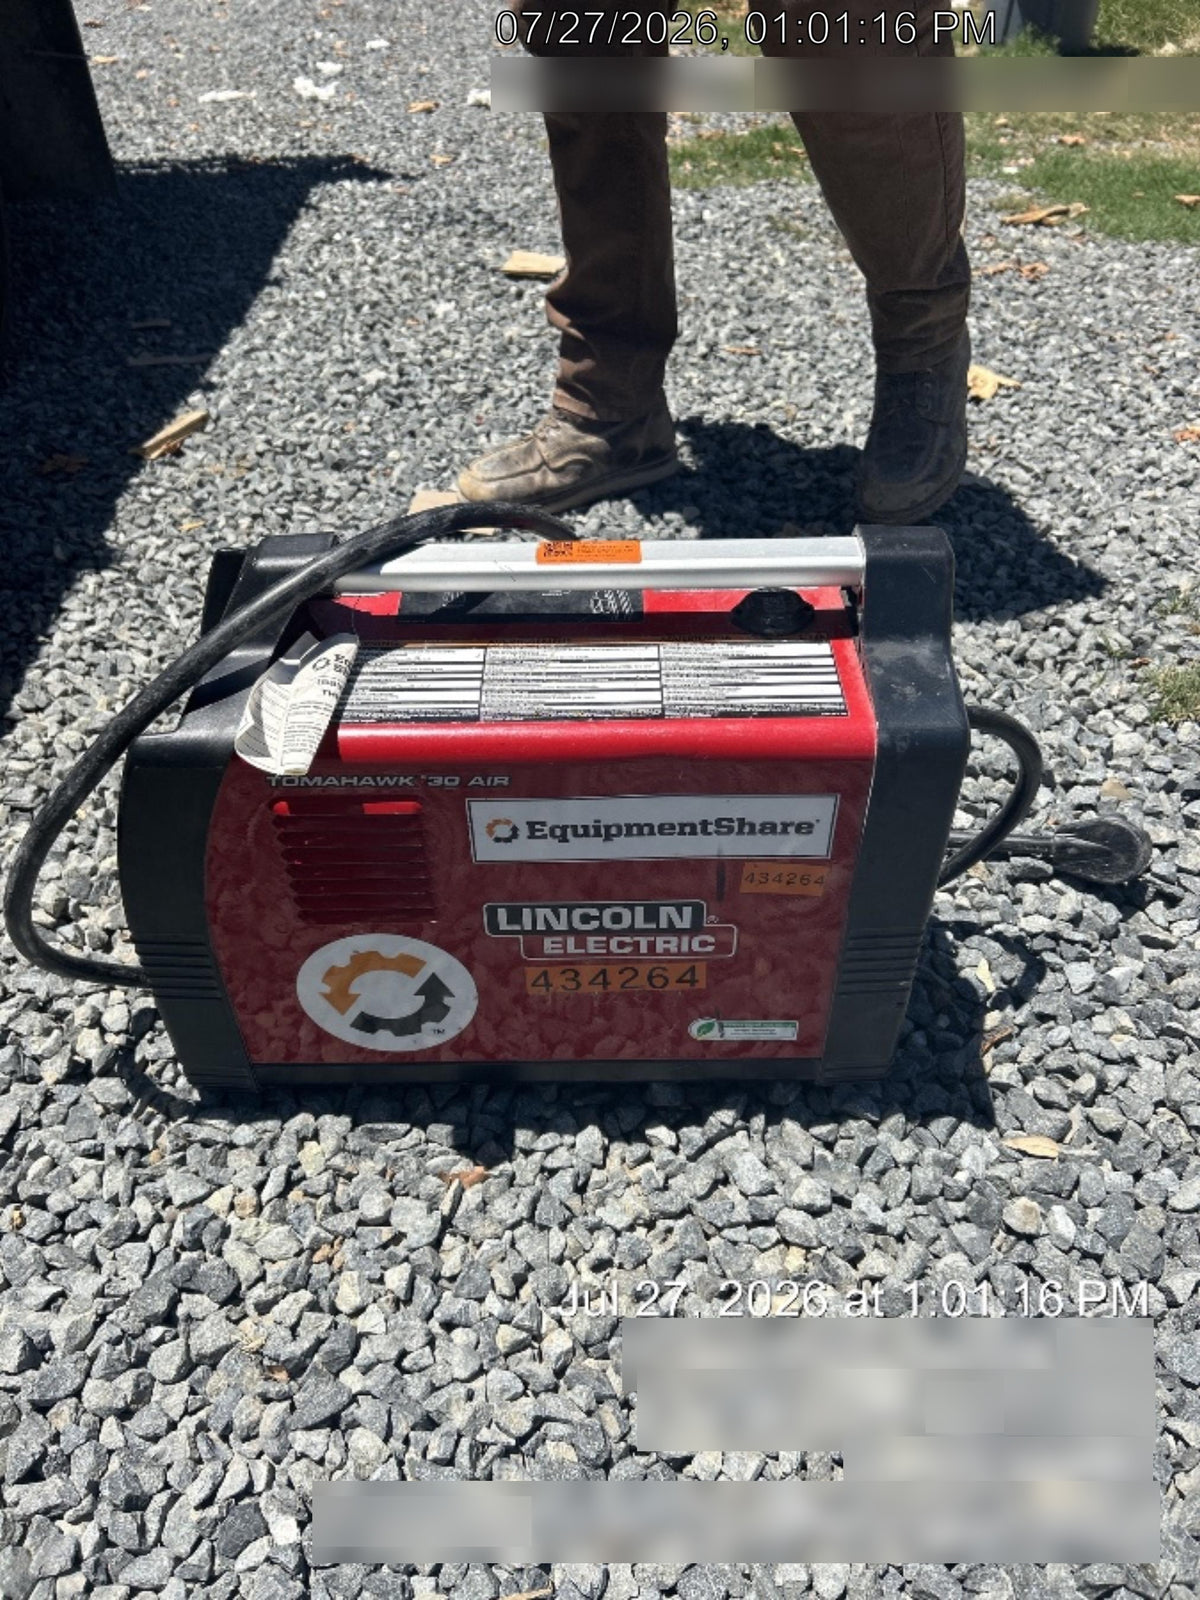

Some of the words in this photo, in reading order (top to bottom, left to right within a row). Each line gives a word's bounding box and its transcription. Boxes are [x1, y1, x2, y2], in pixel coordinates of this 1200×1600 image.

[267, 775, 414, 787] TOMAHAWK
[468, 776, 510, 787] AIR
[526, 817, 814, 842] EquipmentShare
[744, 872, 825, 886] 434264
[497, 906, 693, 931] LINCOLN
[543, 935, 716, 954] ELECTRIC
[531, 964, 699, 993] 434264
